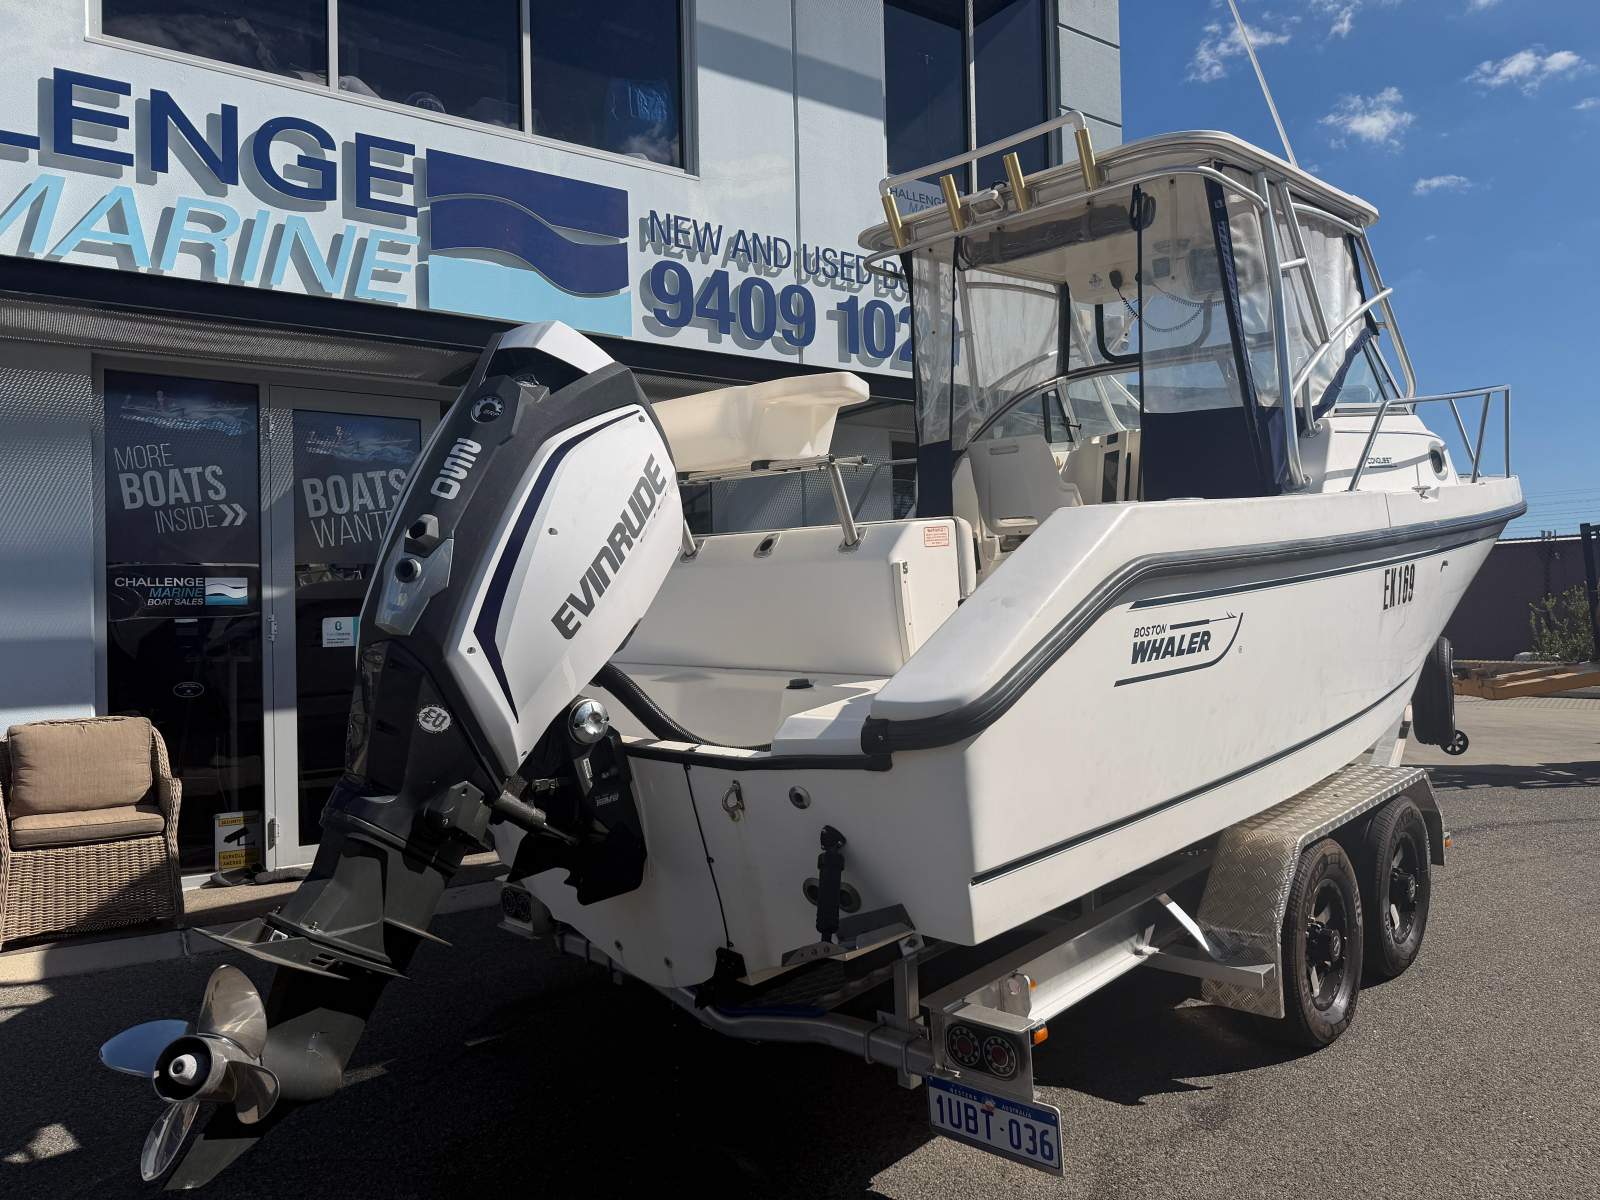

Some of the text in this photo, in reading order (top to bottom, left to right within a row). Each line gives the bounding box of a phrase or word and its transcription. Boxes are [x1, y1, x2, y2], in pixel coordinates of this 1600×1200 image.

[649, 209, 723, 256] NEW
[731, 229, 792, 269] AND
[802, 243, 872, 285] USED
[651, 260, 816, 347] 9409
[114, 443, 174, 470] MORE
[119, 465, 226, 510] BOATS
[154, 504, 218, 534] INSIDE
[310, 509, 394, 548] WANT
[551, 453, 667, 640] EVINRUDE
[114, 577, 204, 587] CHALLENGE
[149, 587, 204, 598] MARINE
[147, 598, 204, 606] BOAT SALES
[1133, 623, 1168, 638] BOSTON
[1131, 630, 1211, 665] WHALER
